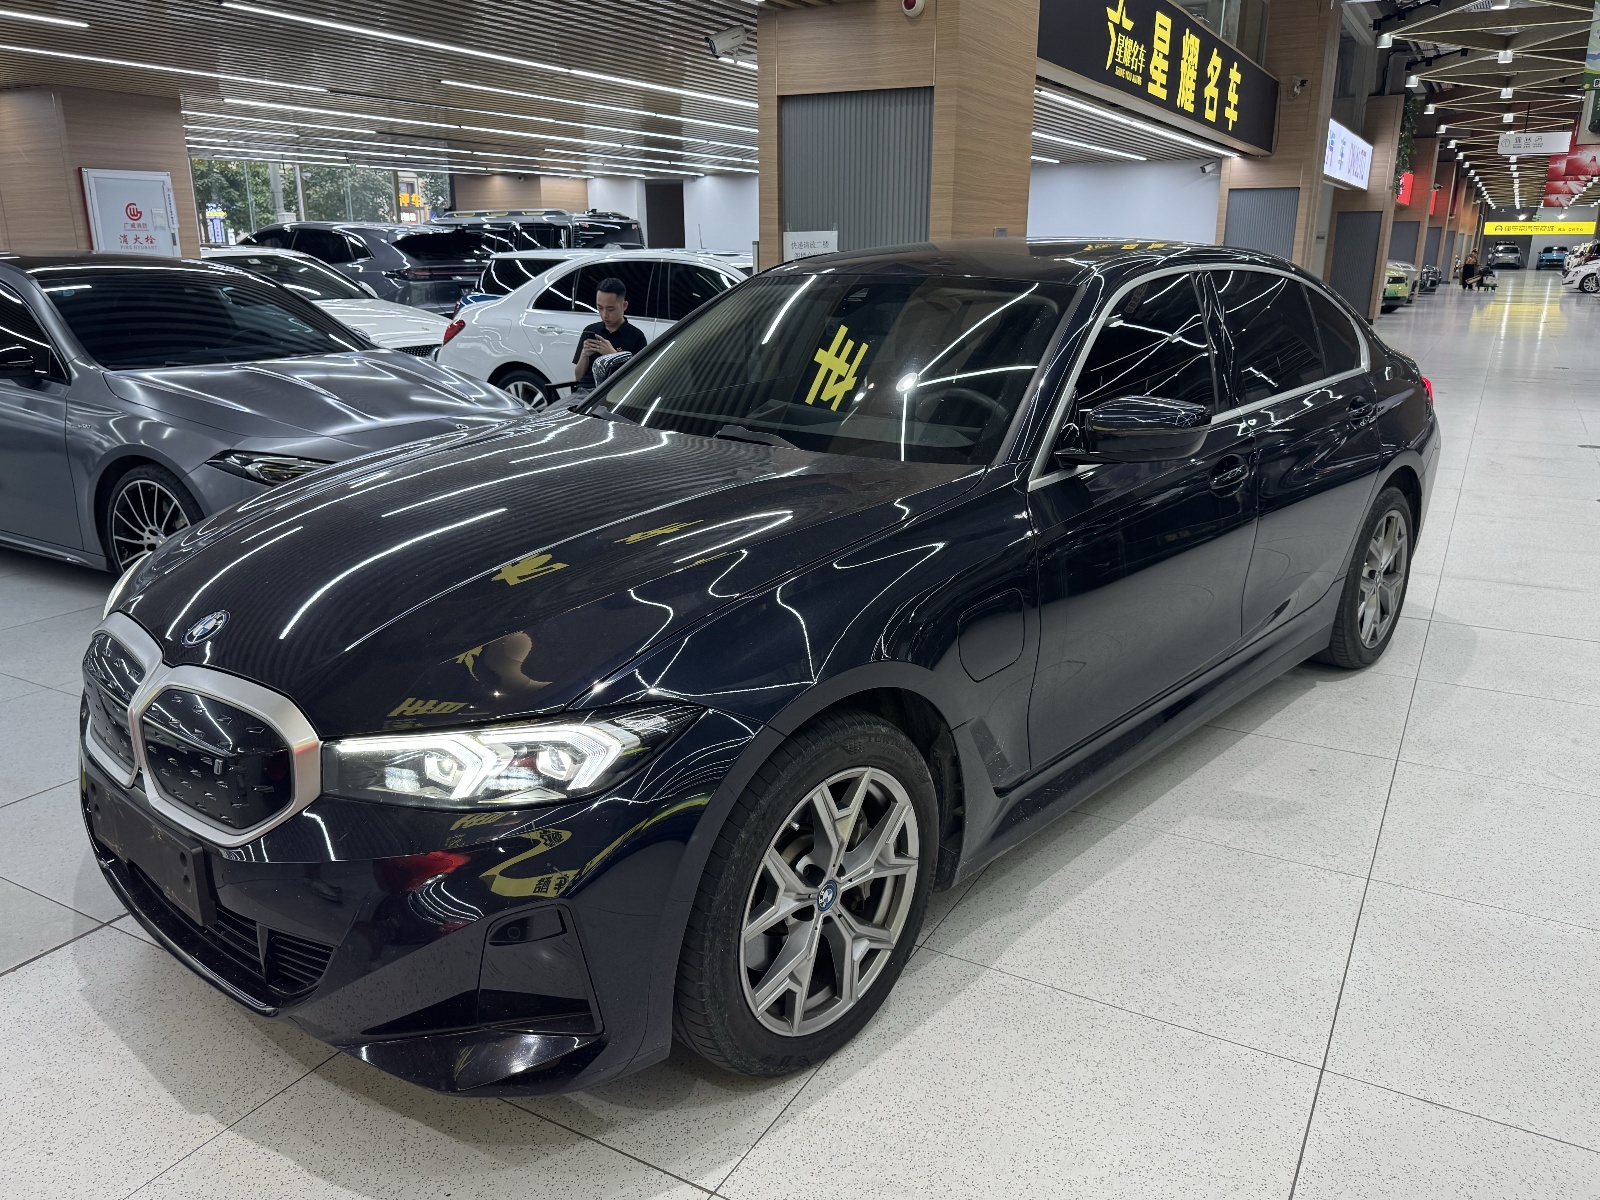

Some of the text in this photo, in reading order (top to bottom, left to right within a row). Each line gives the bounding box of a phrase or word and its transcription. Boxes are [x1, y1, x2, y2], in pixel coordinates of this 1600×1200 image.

[1114, 32, 1147, 74] 星耀名车
[1147, 10, 1242, 131] 星耀名车
[118, 233, 156, 245] 消火栓
